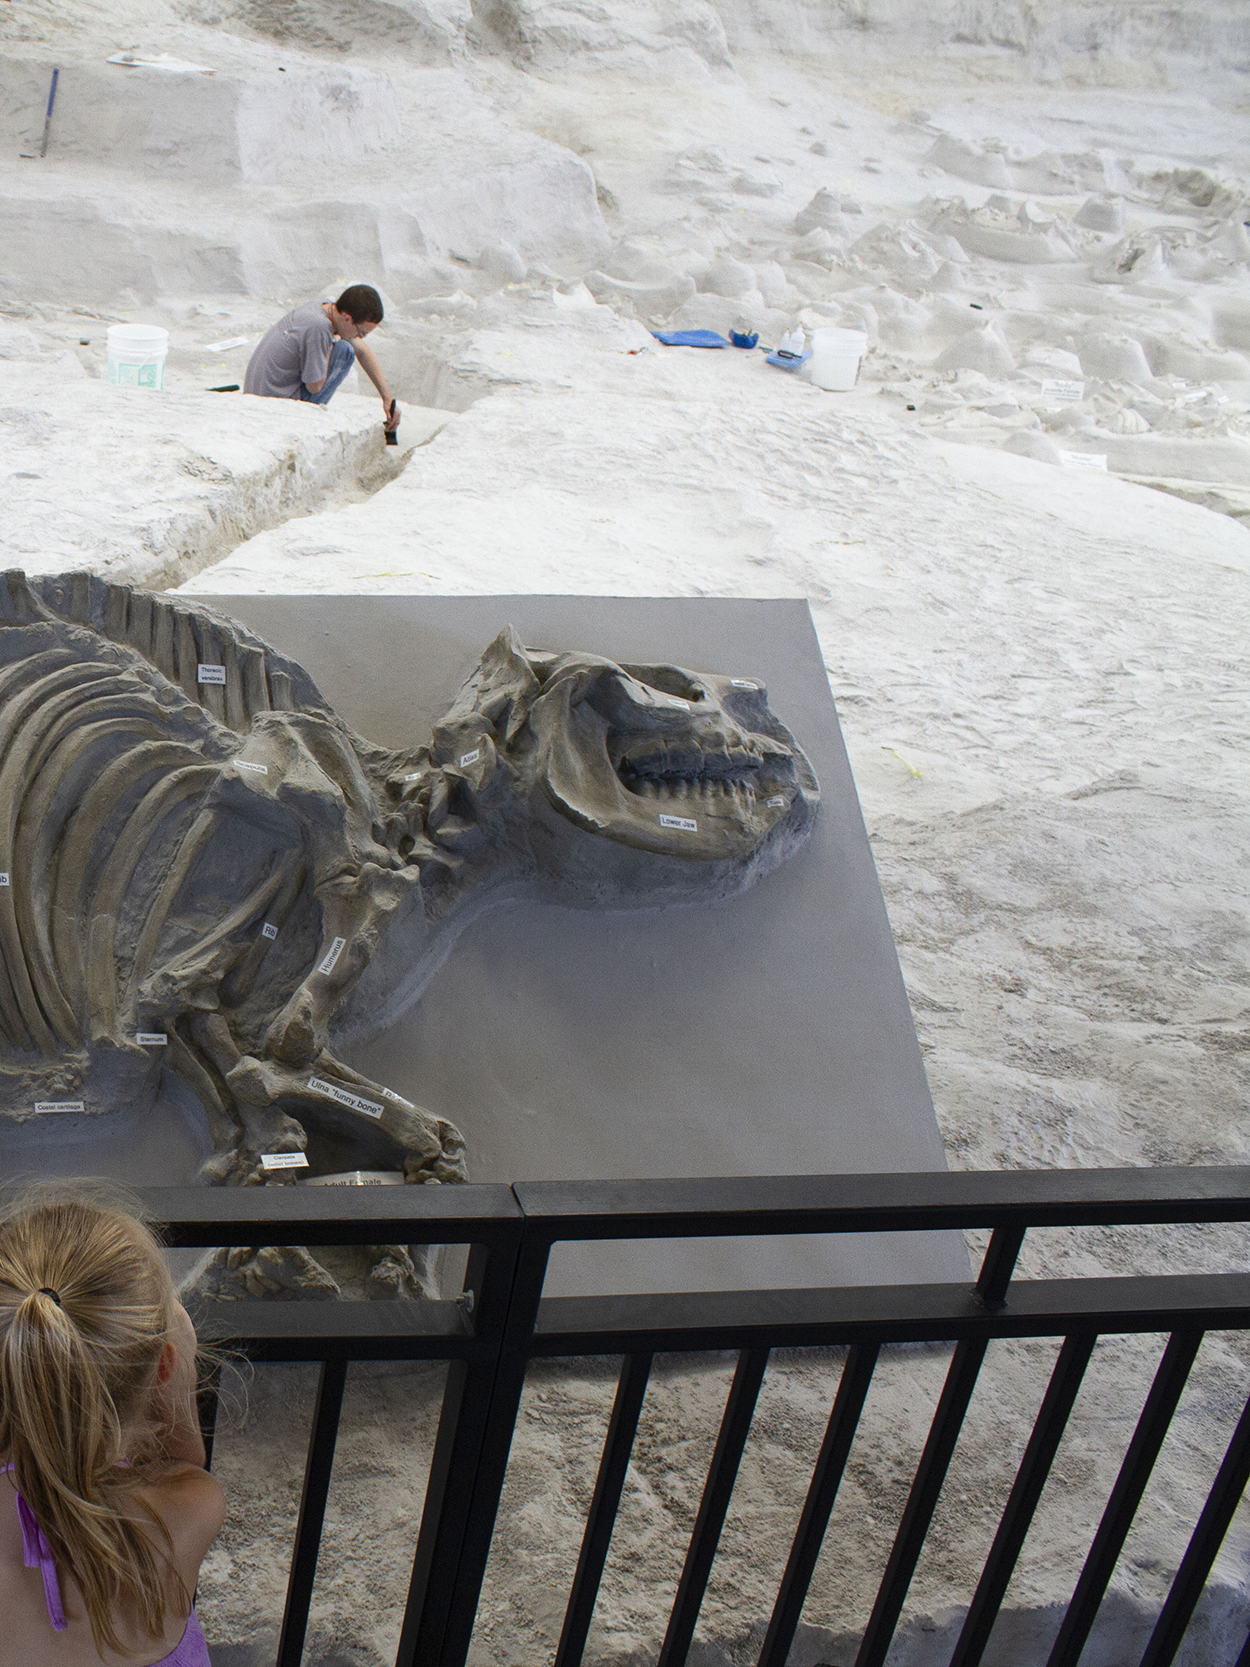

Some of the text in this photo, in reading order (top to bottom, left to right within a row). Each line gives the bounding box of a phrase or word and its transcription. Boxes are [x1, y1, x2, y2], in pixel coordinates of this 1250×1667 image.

[201, 666, 223, 674] Thoracic
[661, 816, 696, 829] Lower Jaw
[264, 925, 276, 937] Rib
[320, 940, 344, 973] Humerus
[140, 1035, 165, 1043] Sternum
[310, 1078, 330, 1095] Ulna
[56, 1103, 81, 1111] cartilage
